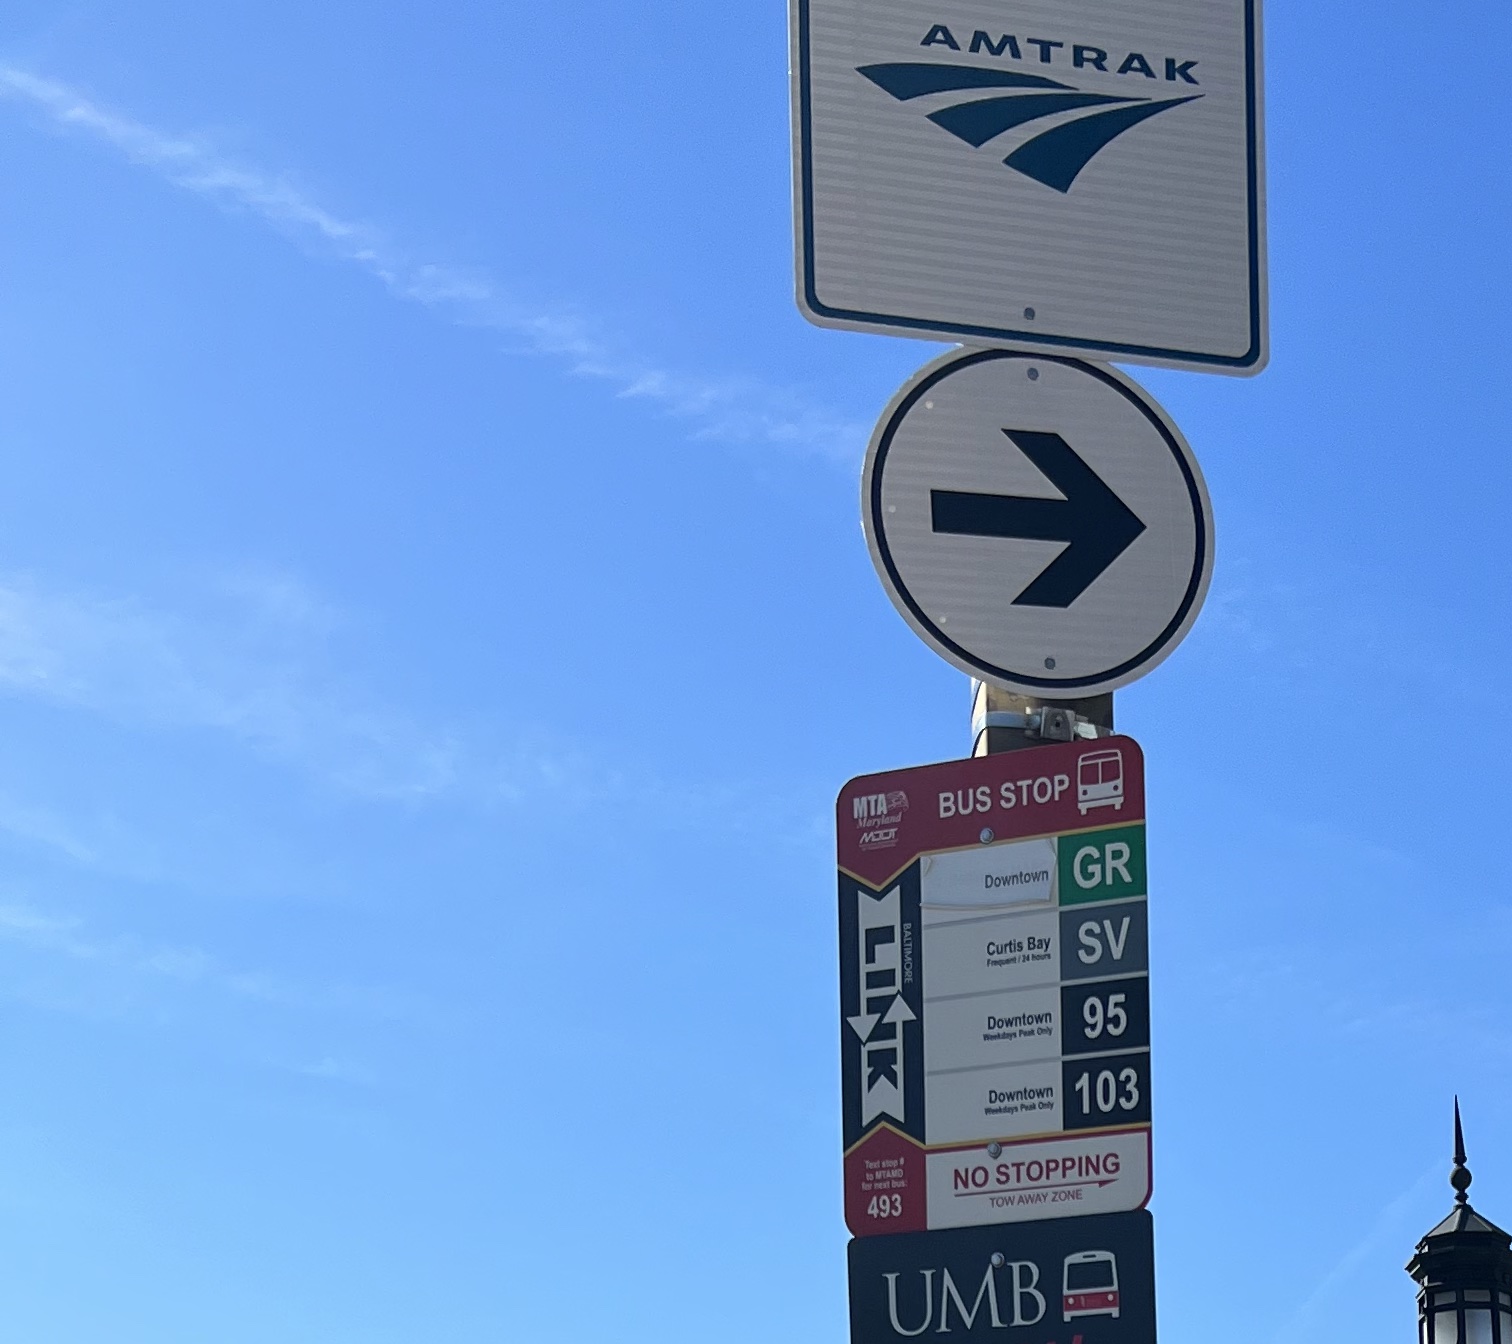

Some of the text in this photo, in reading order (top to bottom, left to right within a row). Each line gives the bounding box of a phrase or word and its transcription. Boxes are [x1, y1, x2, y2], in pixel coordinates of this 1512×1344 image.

[919, 23, 1200, 87] AMTRAK
[853, 793, 888, 819] MTA
[938, 774, 1070, 818] BUS STOP
[857, 811, 903, 829] Maryland
[984, 841, 1133, 889] Downtown GR
[902, 922, 914, 985] BALTIMORE
[986, 916, 1131, 965] Curtis Bay SV
[986, 956, 1017, 968] Frequent
[1022, 954, 1030, 963] 24
[1031, 952, 1051, 962] hours
[864, 924, 899, 1094] LINK
[987, 992, 1128, 1039] Downtown 95
[983, 1026, 1053, 1043] Weekdays Peak Only
[988, 1067, 1140, 1115] Downtown 103
[984, 1100, 1054, 1117] Weekdays Peak Only
[864, 1160, 880, 1170] Text
[881, 1158, 899, 1169] stop
[865, 1172, 874, 1181] to
[954, 1152, 1121, 1190] NO STOPPING
[861, 1181, 872, 1191] for
[873, 1179, 890, 1190] next
[989, 1189, 1083, 1209] TOW AWAY ZONE
[866, 1193, 903, 1220] 493
[881, 1260, 1047, 1338] UMB
